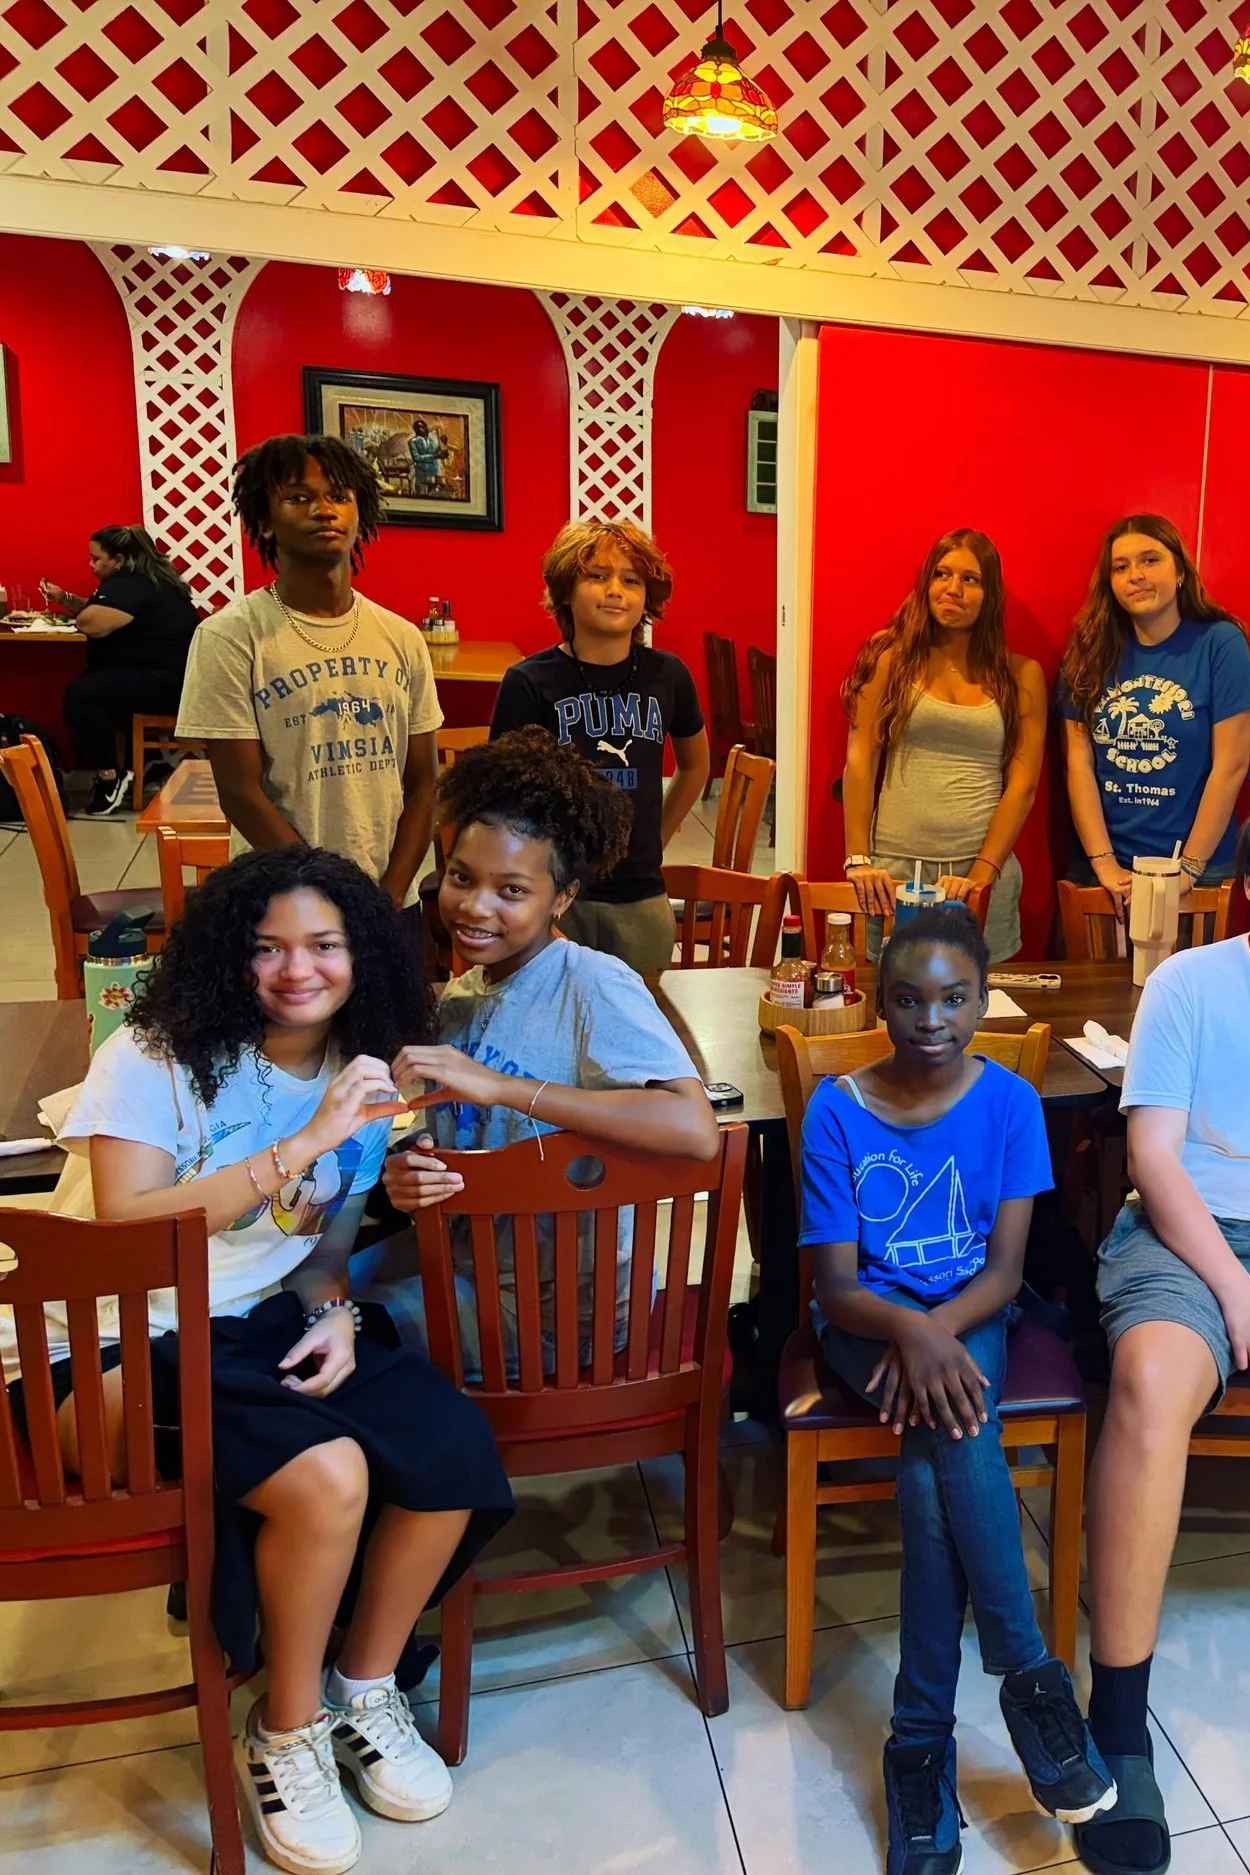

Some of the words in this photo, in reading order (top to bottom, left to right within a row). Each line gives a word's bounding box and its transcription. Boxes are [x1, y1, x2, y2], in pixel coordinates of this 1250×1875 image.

[255, 656, 388, 710] PROPERTY
[338, 700, 371, 715] 1964
[554, 692, 663, 746] PUMA
[284, 714, 307, 728] EST
[311, 735, 394, 764] VIMSIA
[1105, 747, 1177, 773] SCHOOL
[308, 762, 362, 782] ATHLETIC
[1104, 780, 1122, 793] St.
[1126, 783, 1176, 796] Thomas
[888, 1149, 906, 1164] for
[904, 1162, 924, 1188] Life
